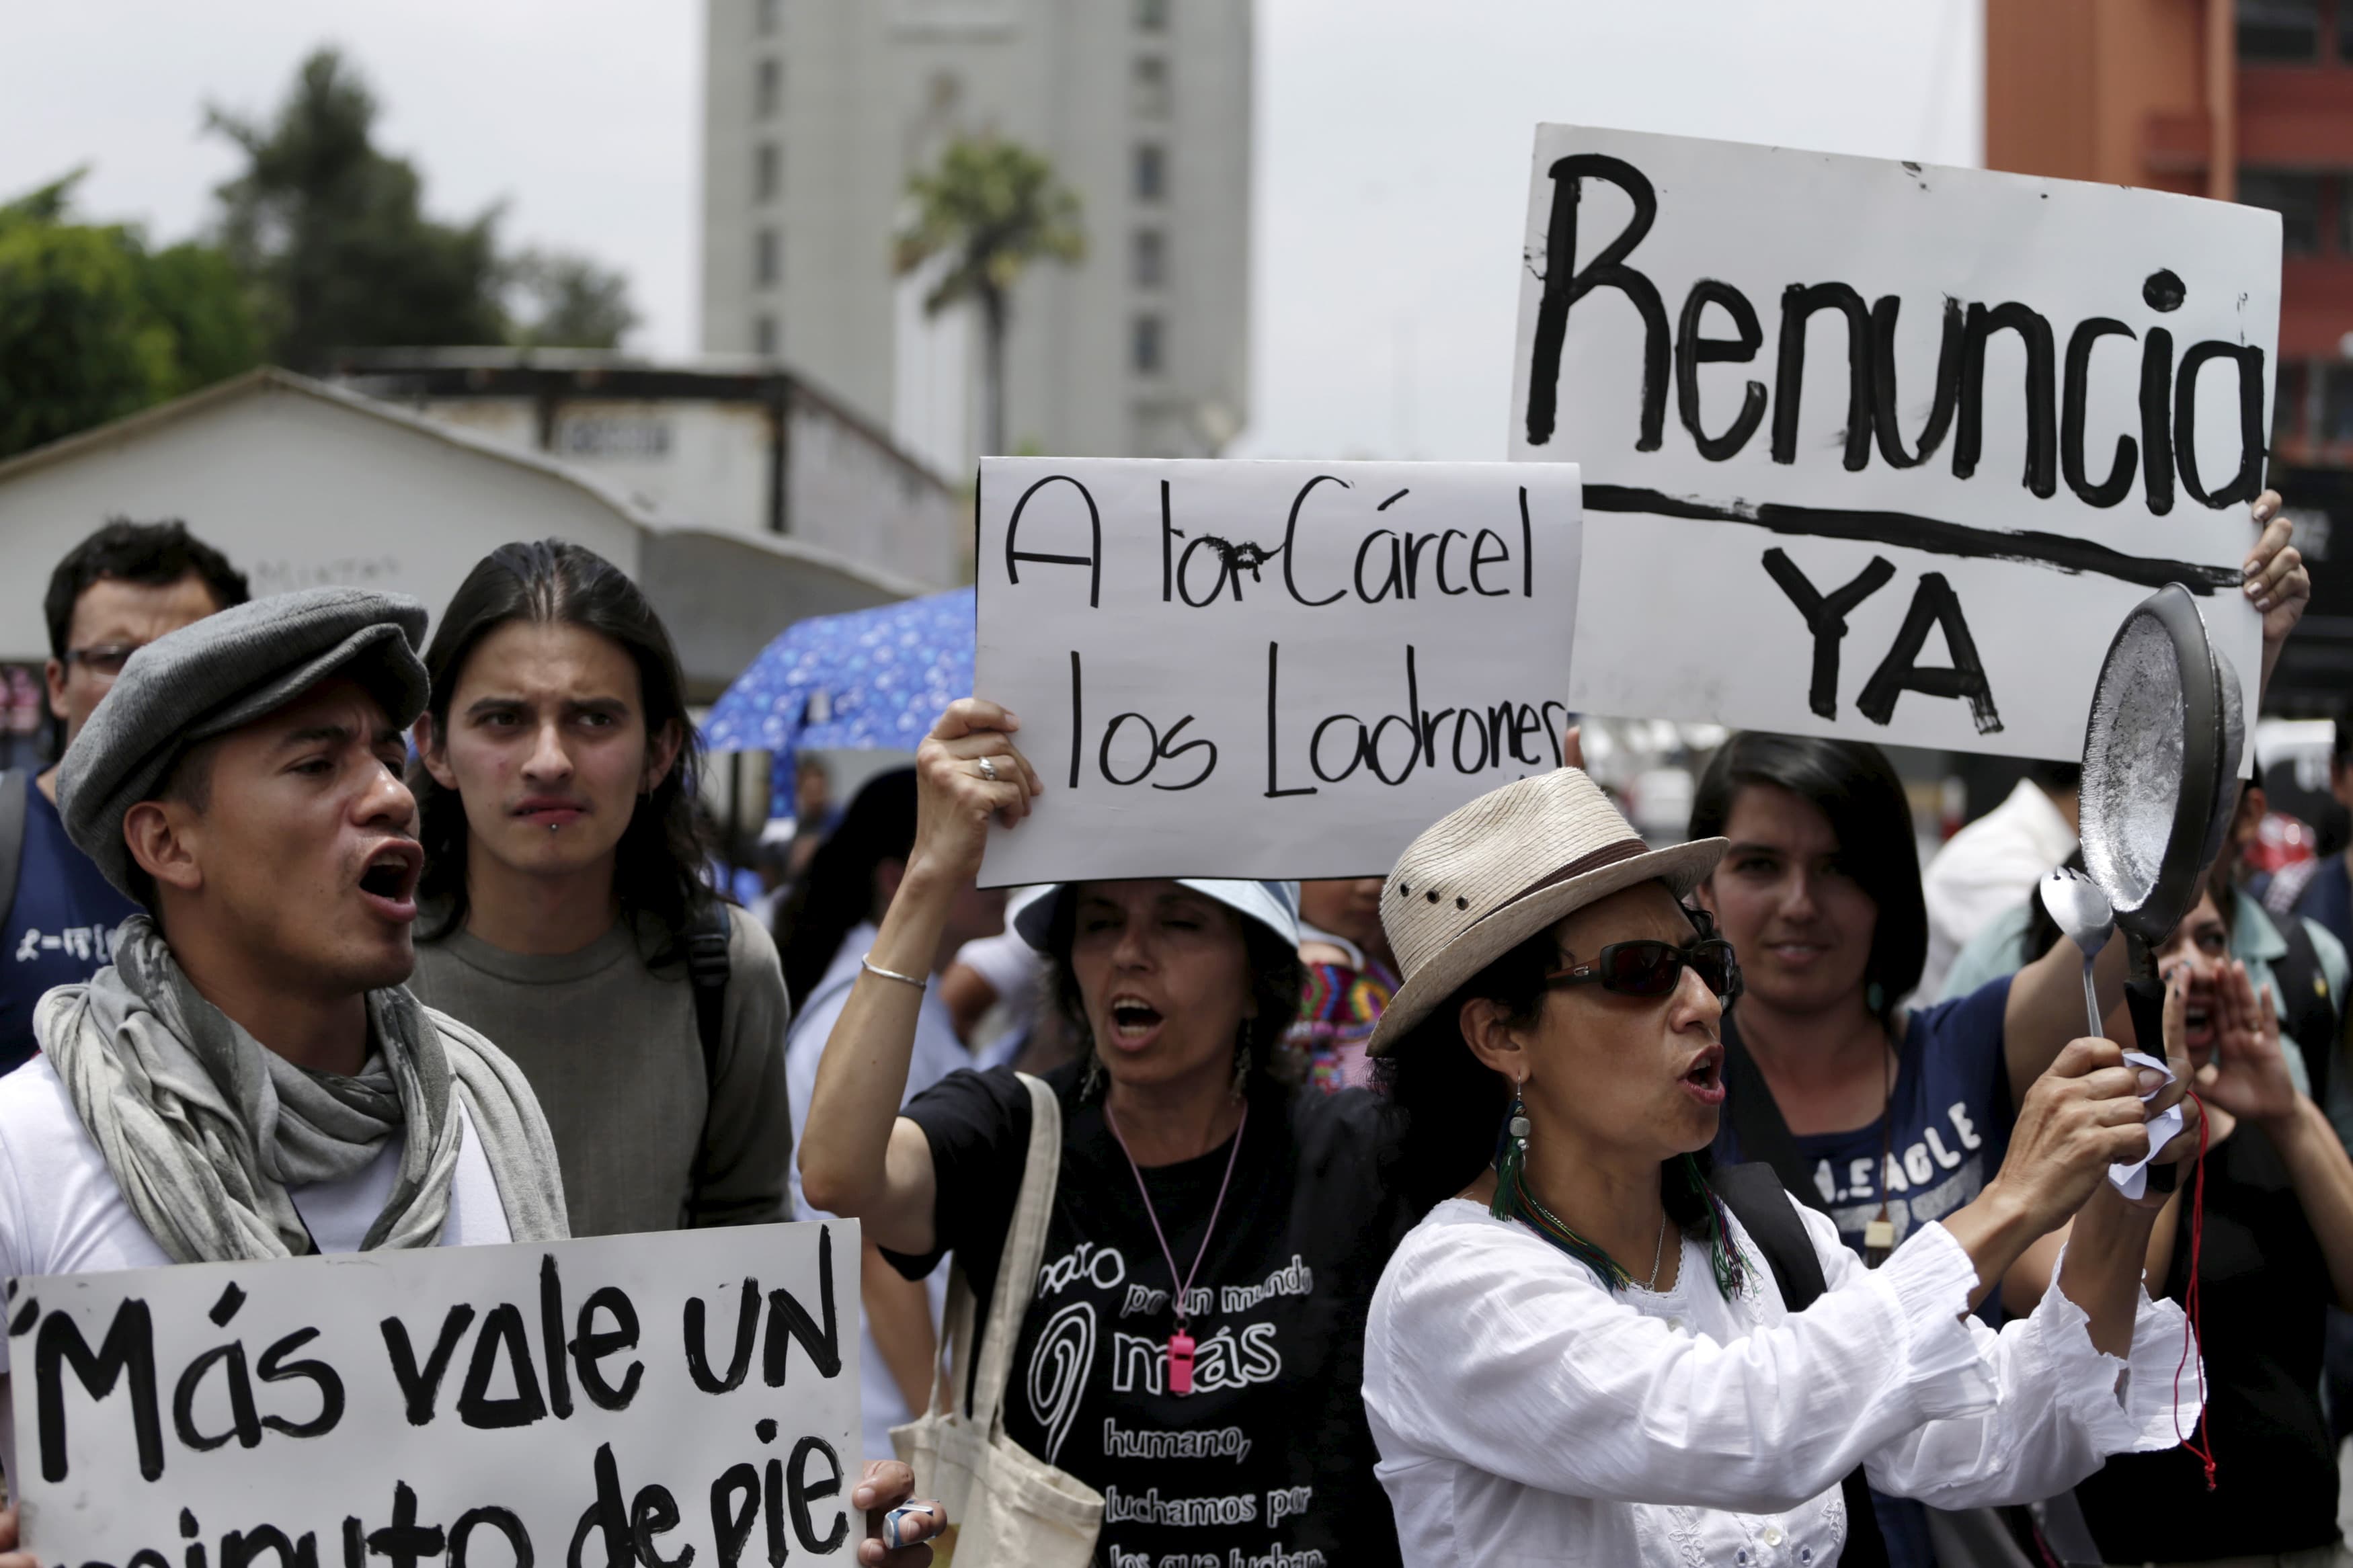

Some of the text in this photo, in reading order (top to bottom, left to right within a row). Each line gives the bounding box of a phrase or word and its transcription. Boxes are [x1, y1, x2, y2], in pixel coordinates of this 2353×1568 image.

[1525, 154, 2268, 516] Renuncia
[1006, 475, 1101, 608] A
[1283, 474, 1533, 607] Cárcel
[1761, 547, 2004, 736] YA
[1069, 641, 1566, 798] los Ladrones
[682, 1224, 842, 1395] UN
[1113, 1322, 1282, 1396] más
[567, 1442, 696, 1568] de
[710, 1417, 850, 1568] pie
[1104, 1417, 1252, 1463] humano,
[1106, 1485, 1312, 1528] luchamos por
